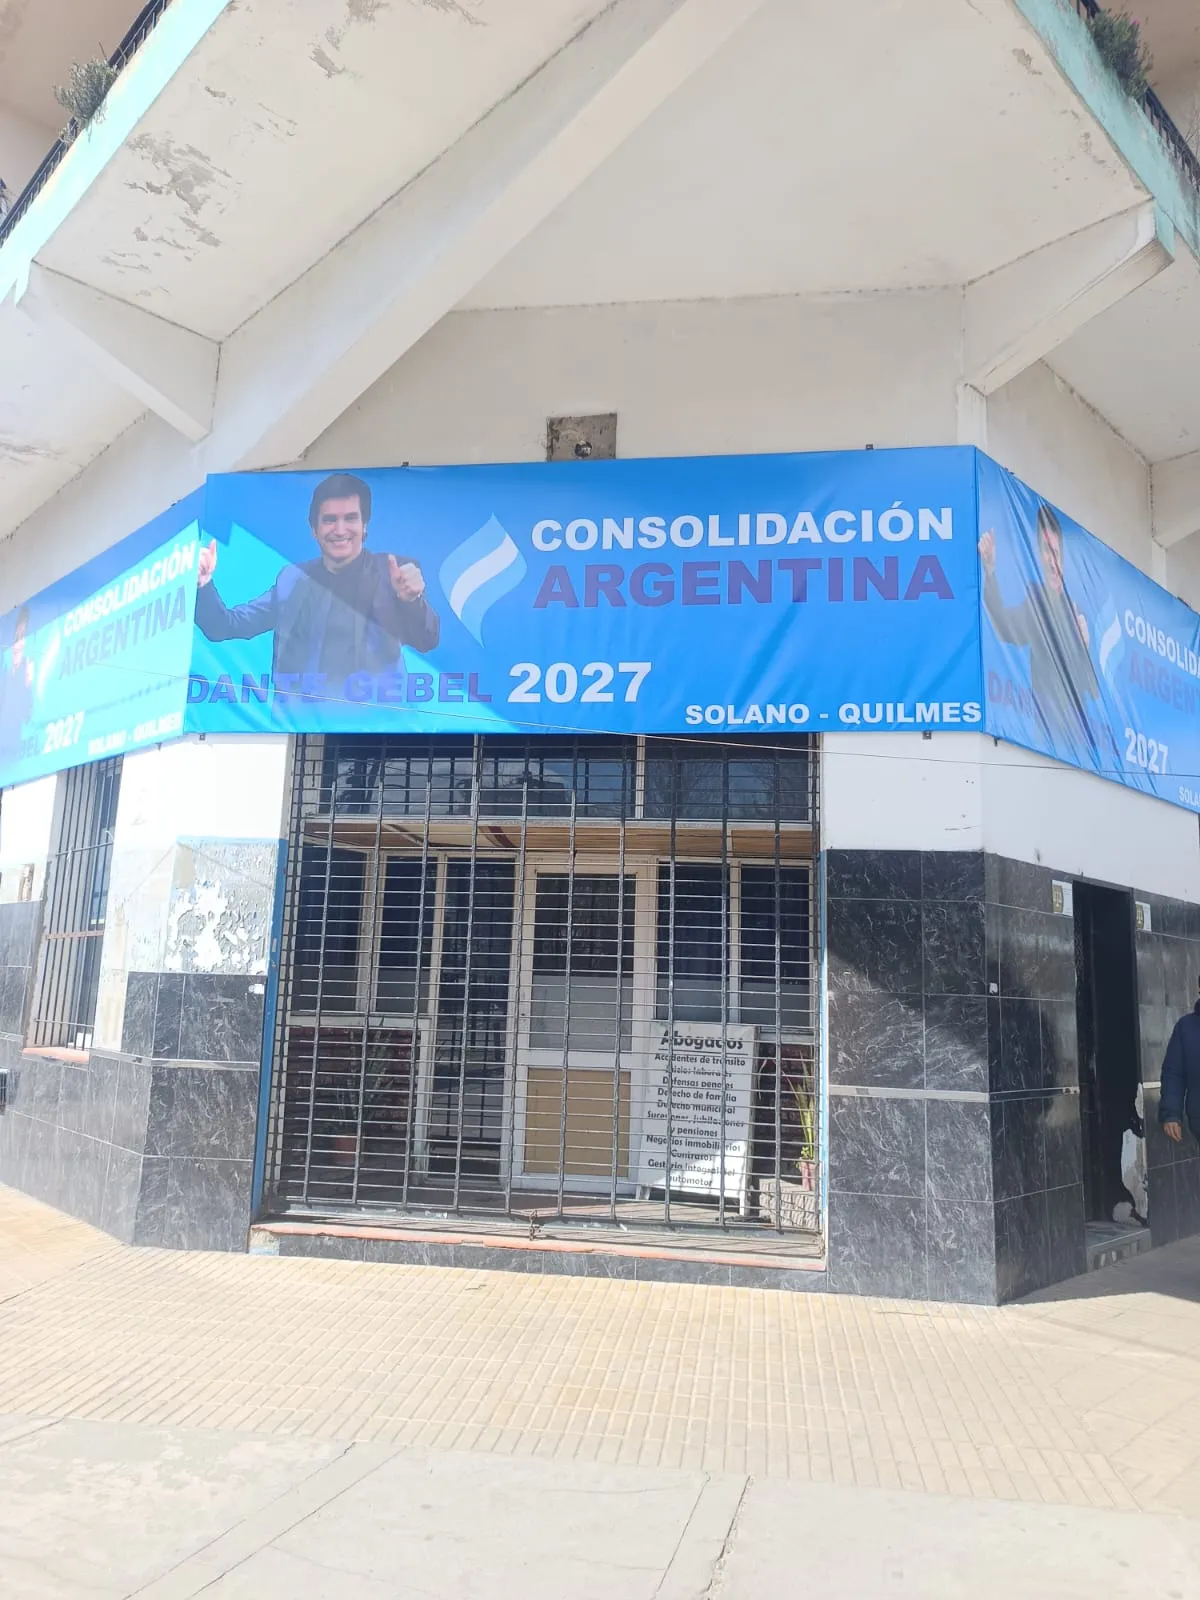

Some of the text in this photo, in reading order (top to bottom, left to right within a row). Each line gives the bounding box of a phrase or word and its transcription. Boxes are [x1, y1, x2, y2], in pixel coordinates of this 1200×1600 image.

[532, 502, 953, 551] CONSOLIDACIÓN
[63, 540, 196, 637] CONSOLIDACIÓN
[533, 555, 955, 608] ARGENTINA
[58, 585, 187, 680] ARGENTINA
[187, 662, 652, 704] DANTE GEBEL 2027
[42, 711, 86, 754] 2027
[686, 704, 810, 726] SOLANO
[838, 702, 981, 726] QUILMES
[1124, 727, 1169, 776] 2027
[699, 1055, 711, 1064] de
[662, 1076, 699, 1087] Dfensas
[692, 1090, 704, 1100] de
[677, 1126, 718, 1137] pensiones
